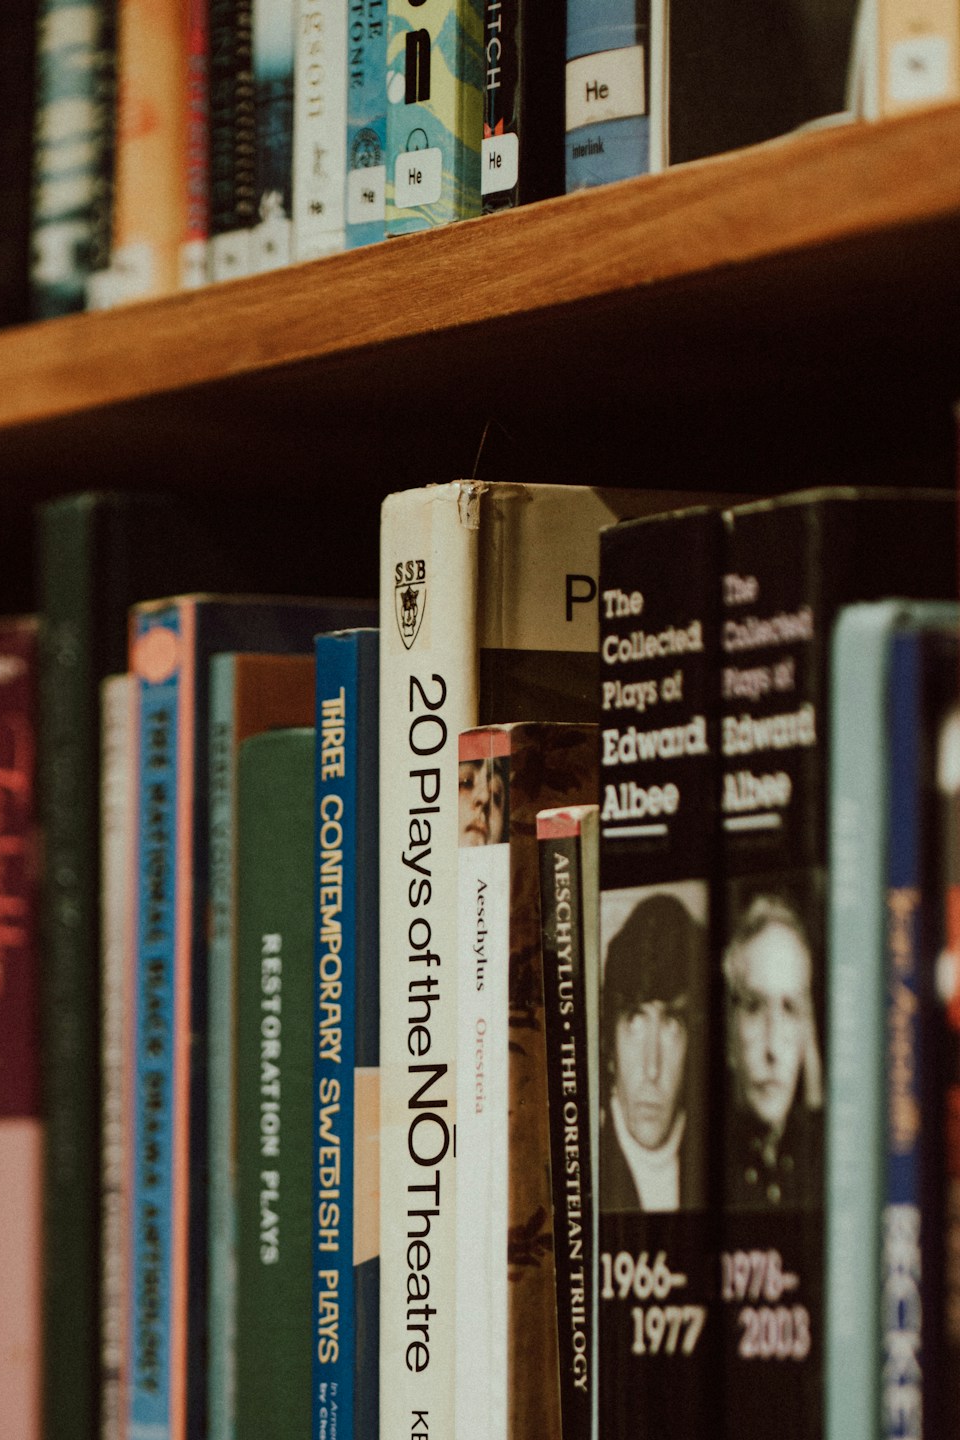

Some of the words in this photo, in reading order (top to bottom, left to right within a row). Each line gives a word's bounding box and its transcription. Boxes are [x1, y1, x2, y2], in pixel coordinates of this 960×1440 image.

[585, 80, 609, 102] He
[408, 167, 423, 186] He
[489, 151, 502, 170] He
[395, 558, 426, 583] SSB
[602, 588, 644, 619] The
[602, 619, 704, 665] Collected
[320, 685, 345, 781] THREE
[408, 673, 447, 757] 20
[601, 680, 658, 712] Plays
[601, 714, 709, 766] Edward
[401, 767, 441, 908] Plays
[600, 780, 681, 821] Albee
[318, 793, 344, 1064] CONTEMPORARY
[407, 917, 441, 967] of
[473, 878, 488, 992] Aeschylus
[554, 851, 574, 1016] AESCHYLUS
[260, 933, 282, 1158] RESTORATION
[407, 974, 441, 1057] the
[475, 1018, 488, 1115] Oresteia
[559, 1035, 577, 1096] THE
[318, 1077, 341, 1252] SWEDISH
[562, 1101, 583, 1259] ORESTEIAN
[259, 1169, 280, 1265] PLAYS
[405, 1169, 441, 1374] Theatre
[317, 1269, 339, 1364] PLAYS
[569, 1266, 588, 1392] TRILOGY
[631, 1304, 706, 1354] 1977
